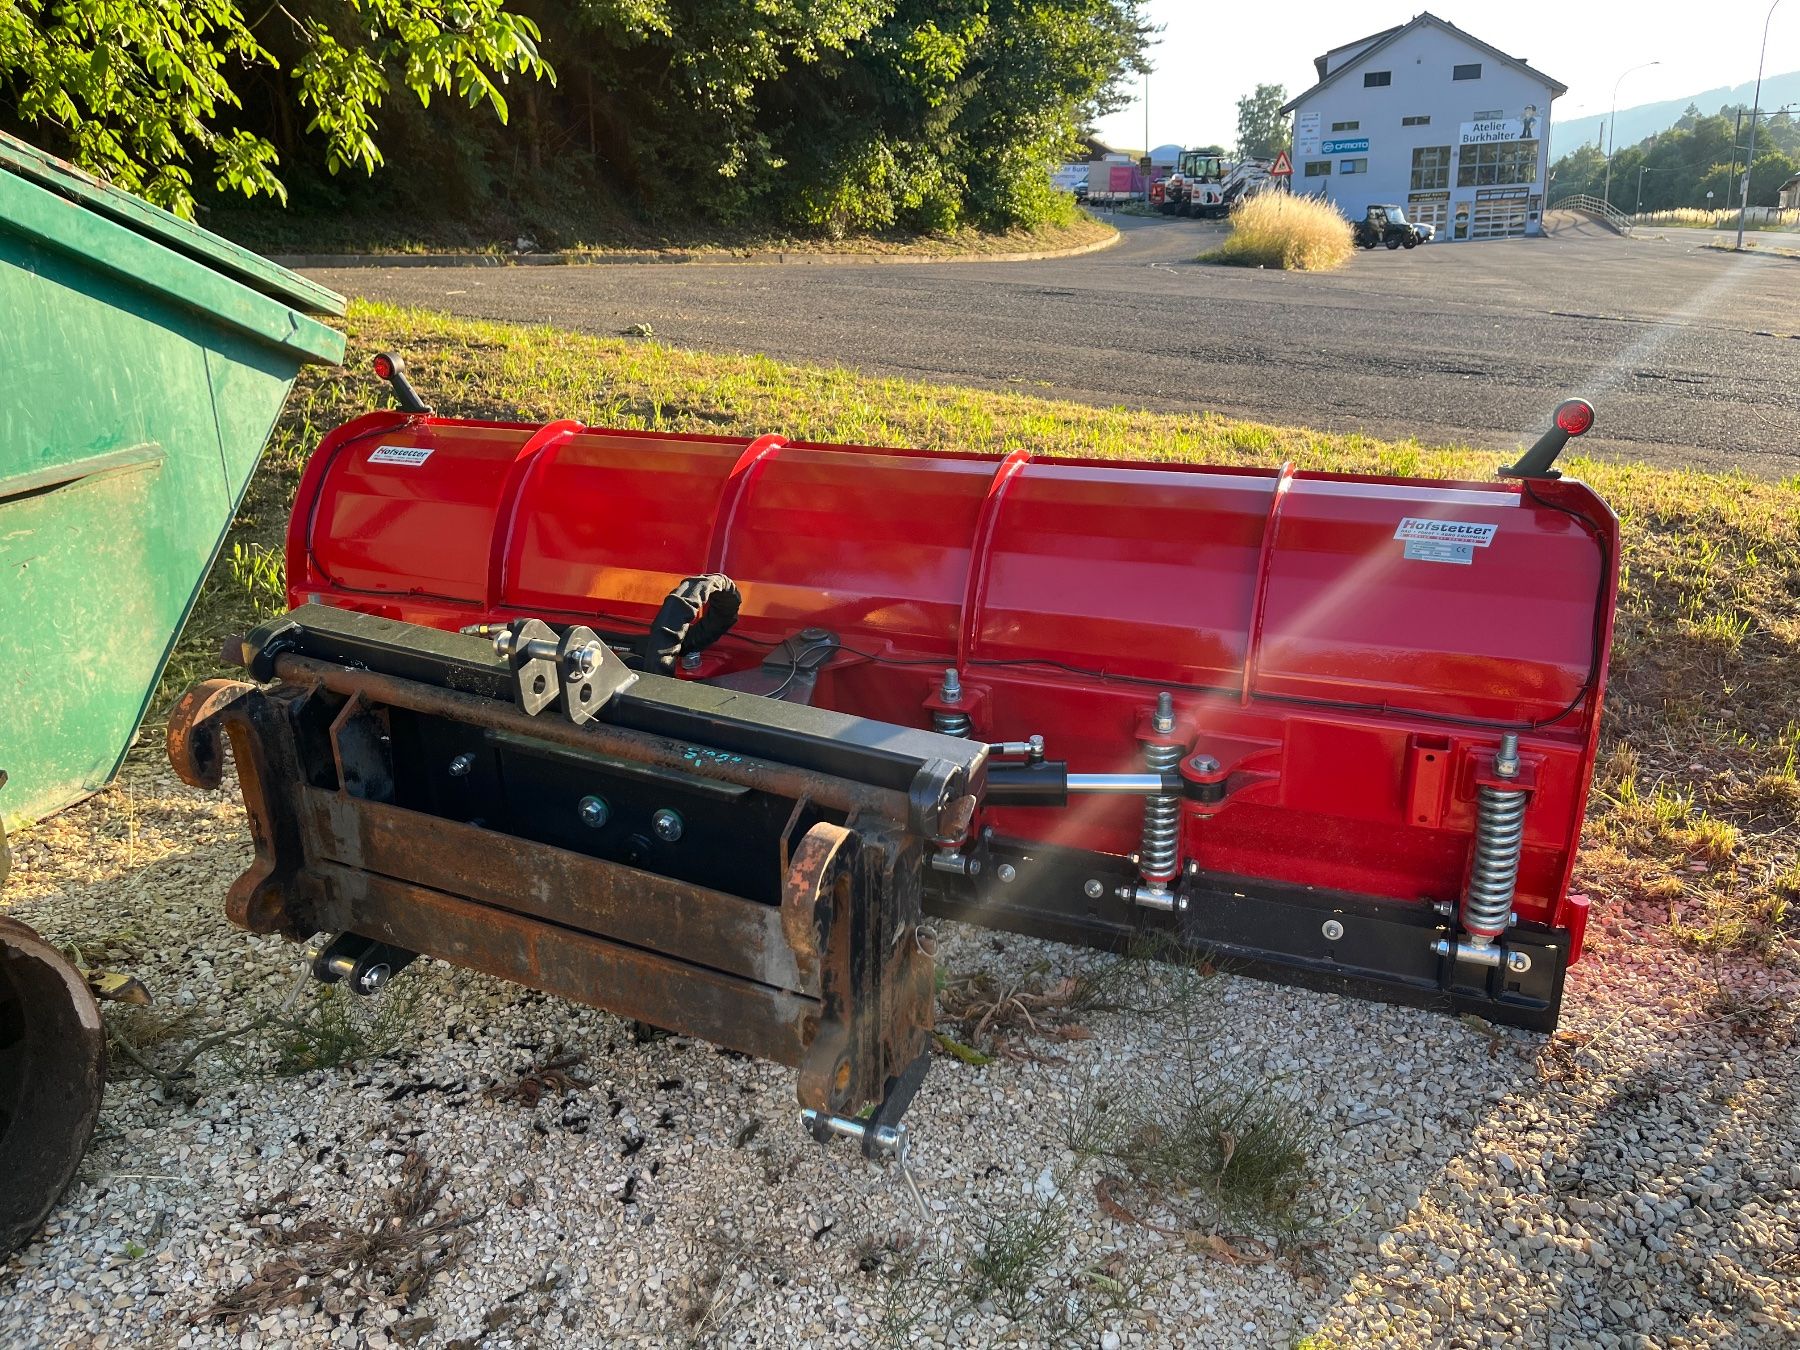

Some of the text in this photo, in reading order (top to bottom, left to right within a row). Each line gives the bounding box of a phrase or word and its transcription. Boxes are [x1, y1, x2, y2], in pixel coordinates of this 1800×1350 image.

[1473, 121, 1507, 132] Atelier
[1462, 132, 1516, 143] Burkhalter
[377, 448, 428, 457] Hofstetter
[1402, 520, 1492, 535] Hofstetter
